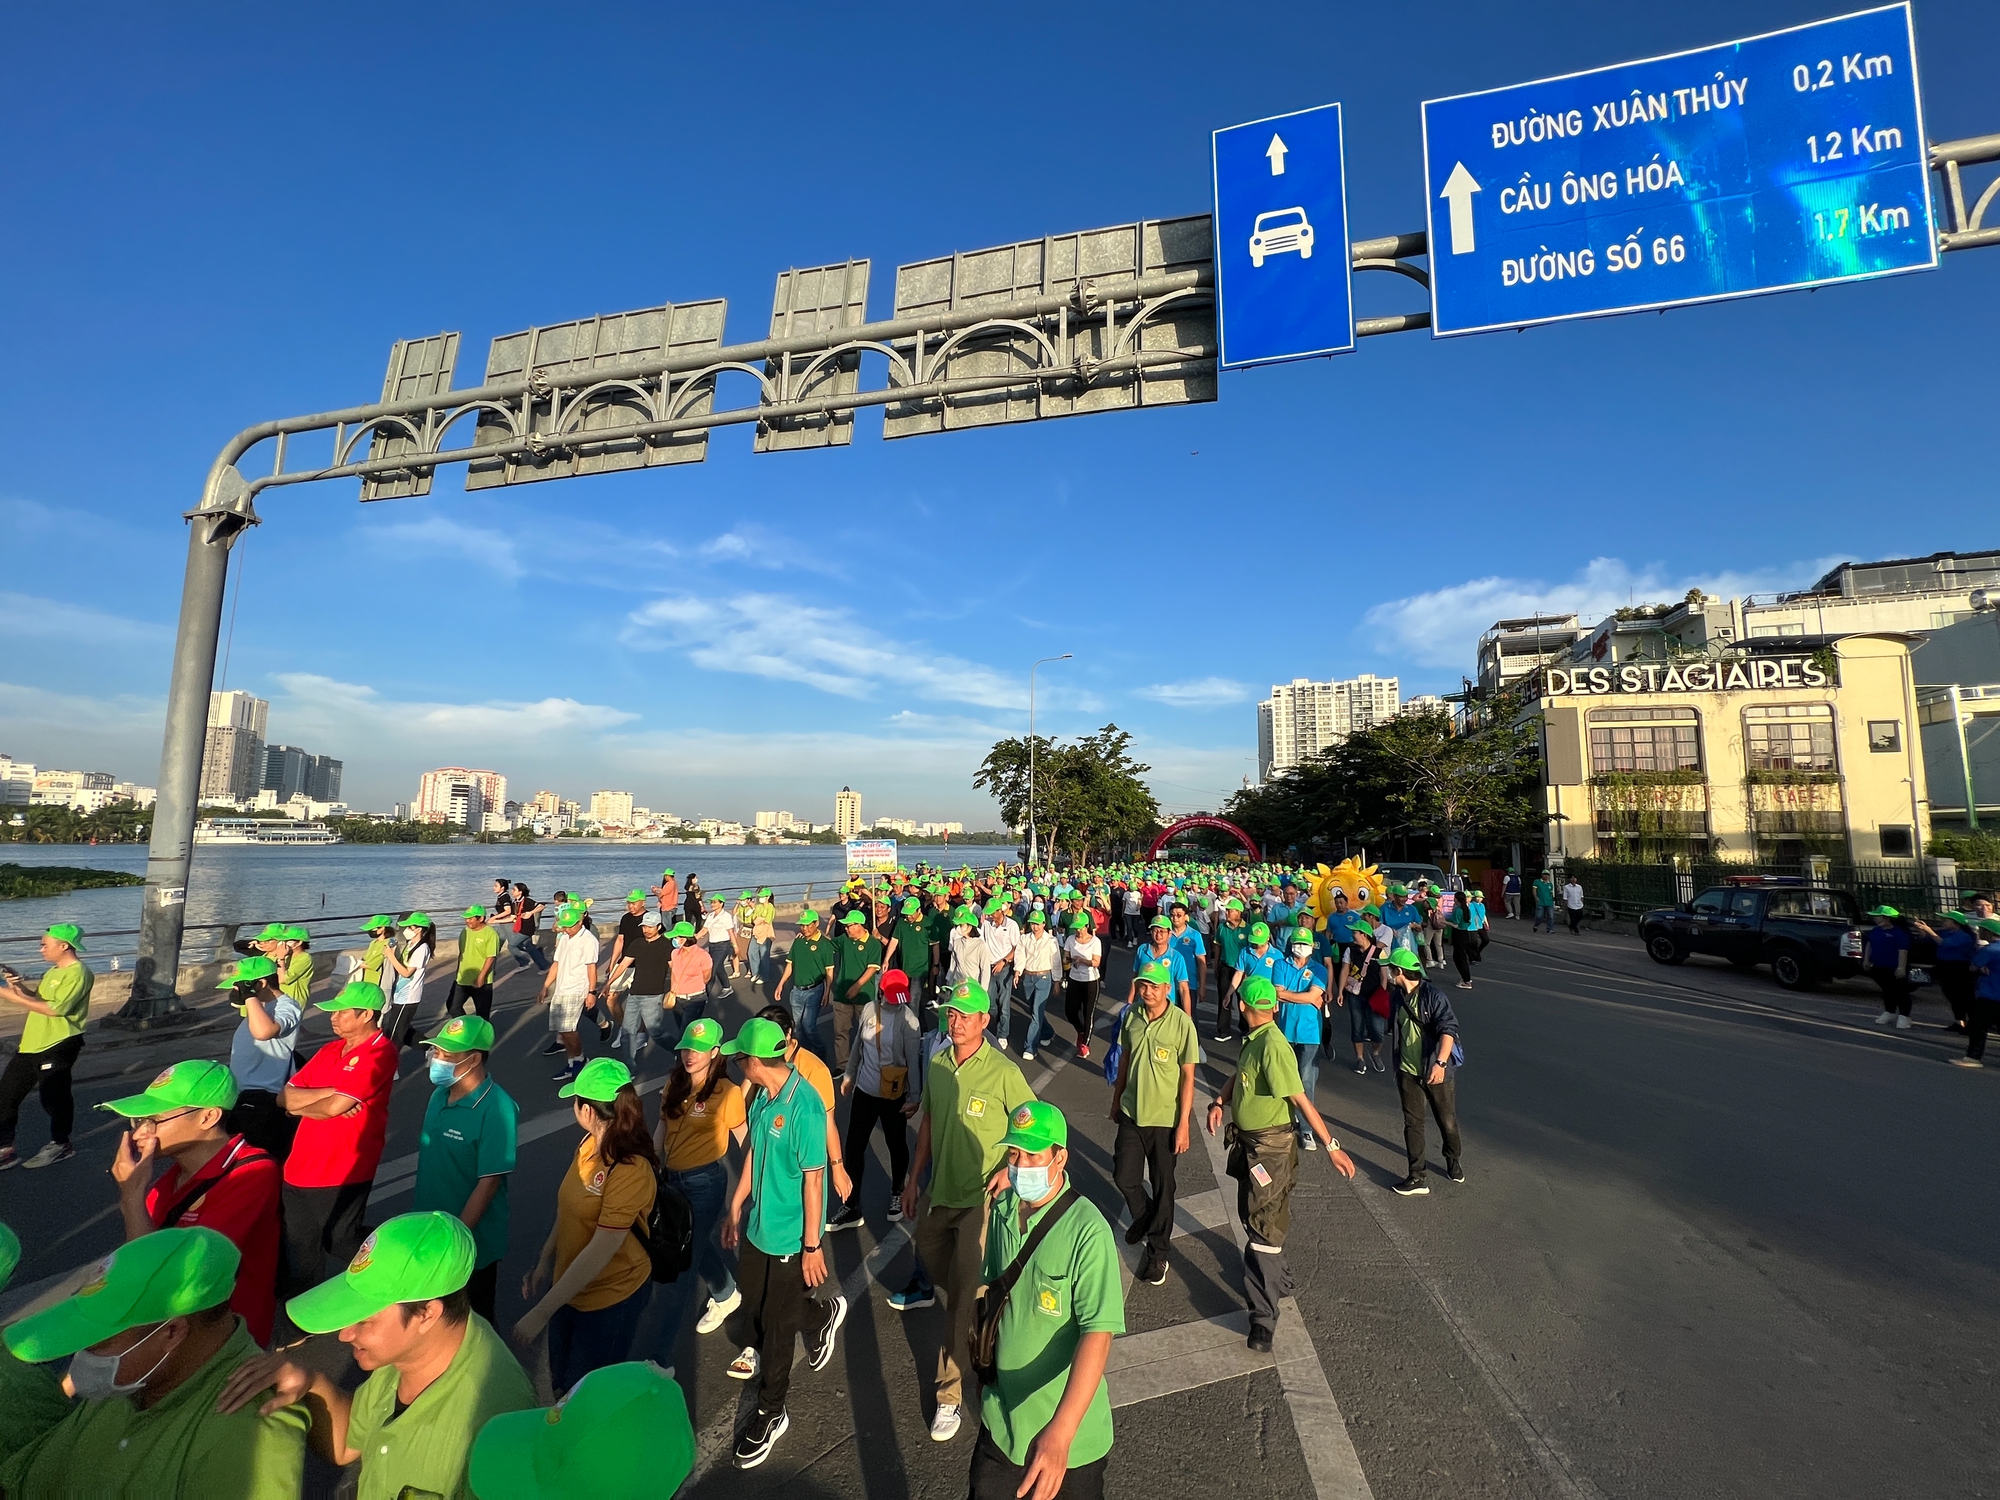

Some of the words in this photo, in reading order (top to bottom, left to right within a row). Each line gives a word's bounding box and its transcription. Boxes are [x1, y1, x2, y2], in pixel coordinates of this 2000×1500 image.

[1793, 59, 1835, 92] 0,2
[1842, 52, 1893, 83] Km
[1491, 108, 1583, 149] ĐƯỜNG
[1592, 89, 1668, 132] XUÂN
[1672, 71, 1749, 116] THỦY
[1806, 131, 1843, 164] 1,2
[1851, 124, 1902, 155] Km
[1500, 171, 1551, 214] CẦU
[1561, 170, 1618, 205] ÔNG
[1626, 153, 1685, 195] HÓA
[1859, 203, 1910, 235] Km
[1501, 244, 1595, 287] ĐƯỜNG
[1606, 226, 1644, 272] SỐ
[1652, 234, 1686, 265] 66
[1547, 668, 1610, 696] DES
[1620, 657, 1828, 693] STAGIAIRES
